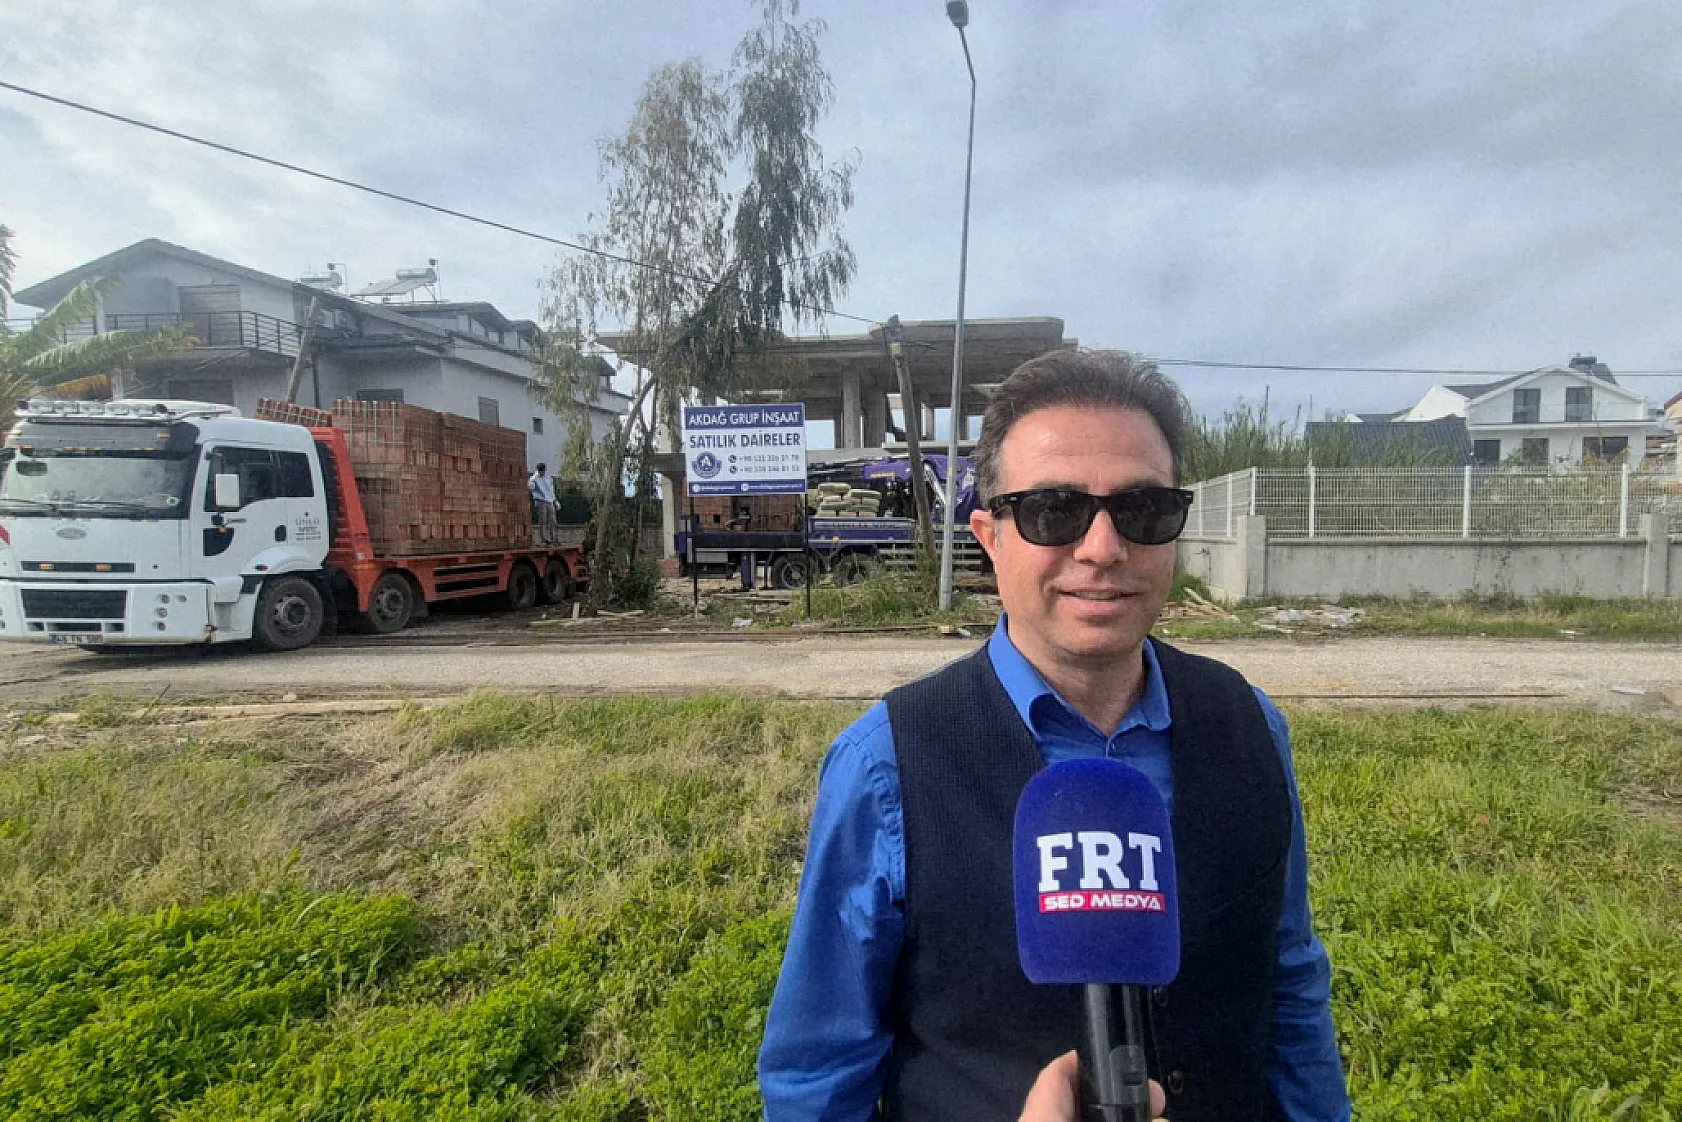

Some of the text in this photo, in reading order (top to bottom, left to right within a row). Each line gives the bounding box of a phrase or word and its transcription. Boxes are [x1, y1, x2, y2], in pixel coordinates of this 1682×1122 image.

[689, 409, 800, 426] AKDAĞ GRUP İNŞAAT
[689, 430, 801, 449] SATILIK DAİRELER
[1036, 830, 1163, 893] FRT
[1044, 893, 1161, 910] SED MEDYA
